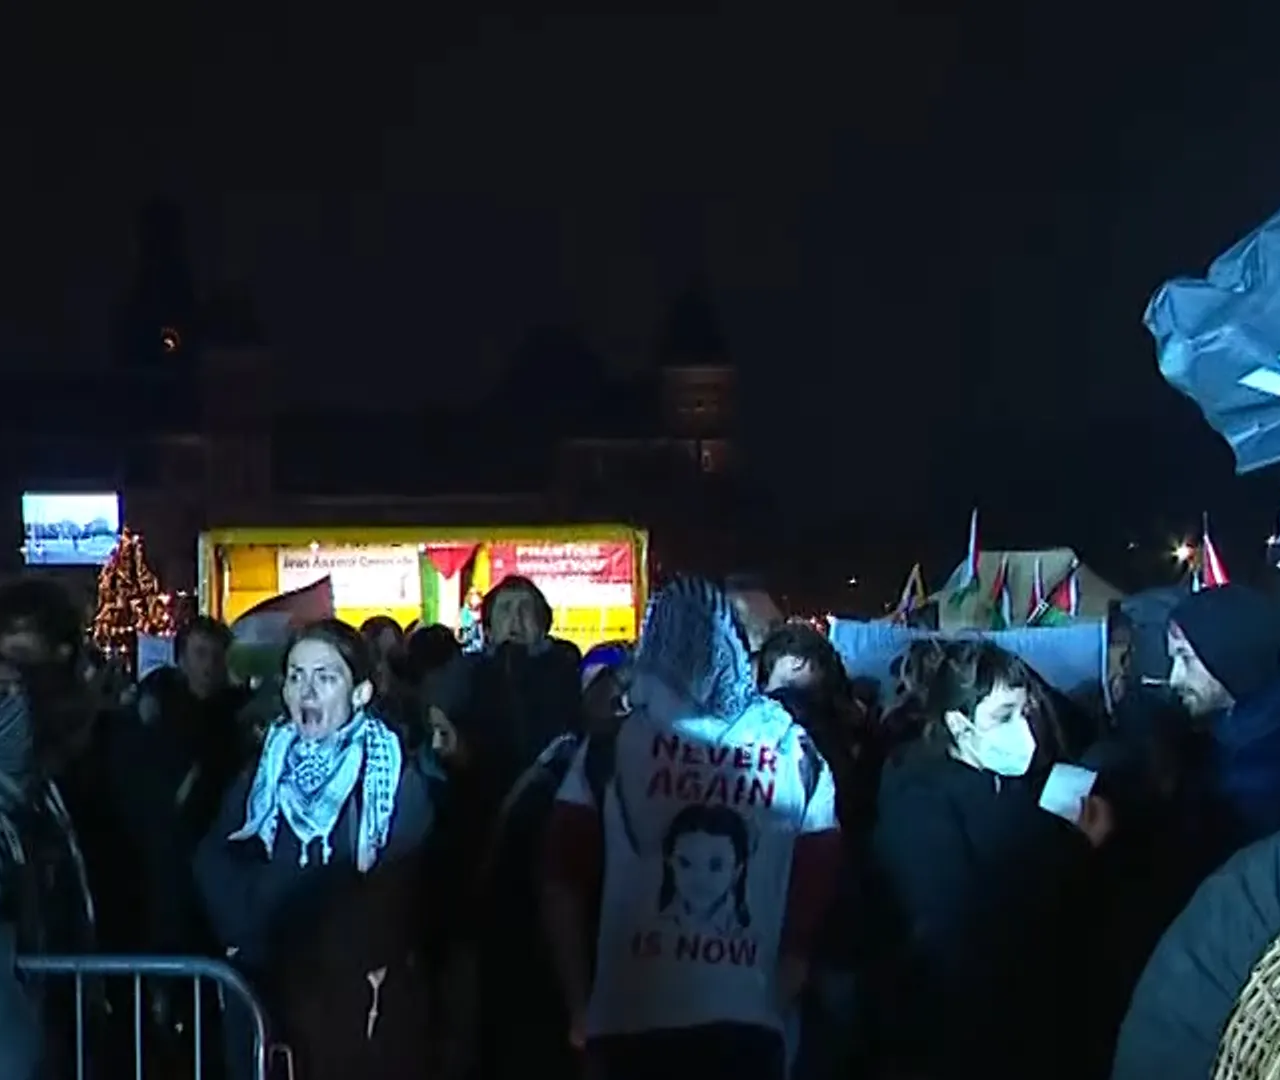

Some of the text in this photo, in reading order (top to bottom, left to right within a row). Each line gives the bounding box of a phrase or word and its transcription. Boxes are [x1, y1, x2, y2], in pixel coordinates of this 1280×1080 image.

[652, 732, 778, 773] NEVER
[647, 767, 776, 808] AGAIN
[633, 931, 757, 968] IS NOW
